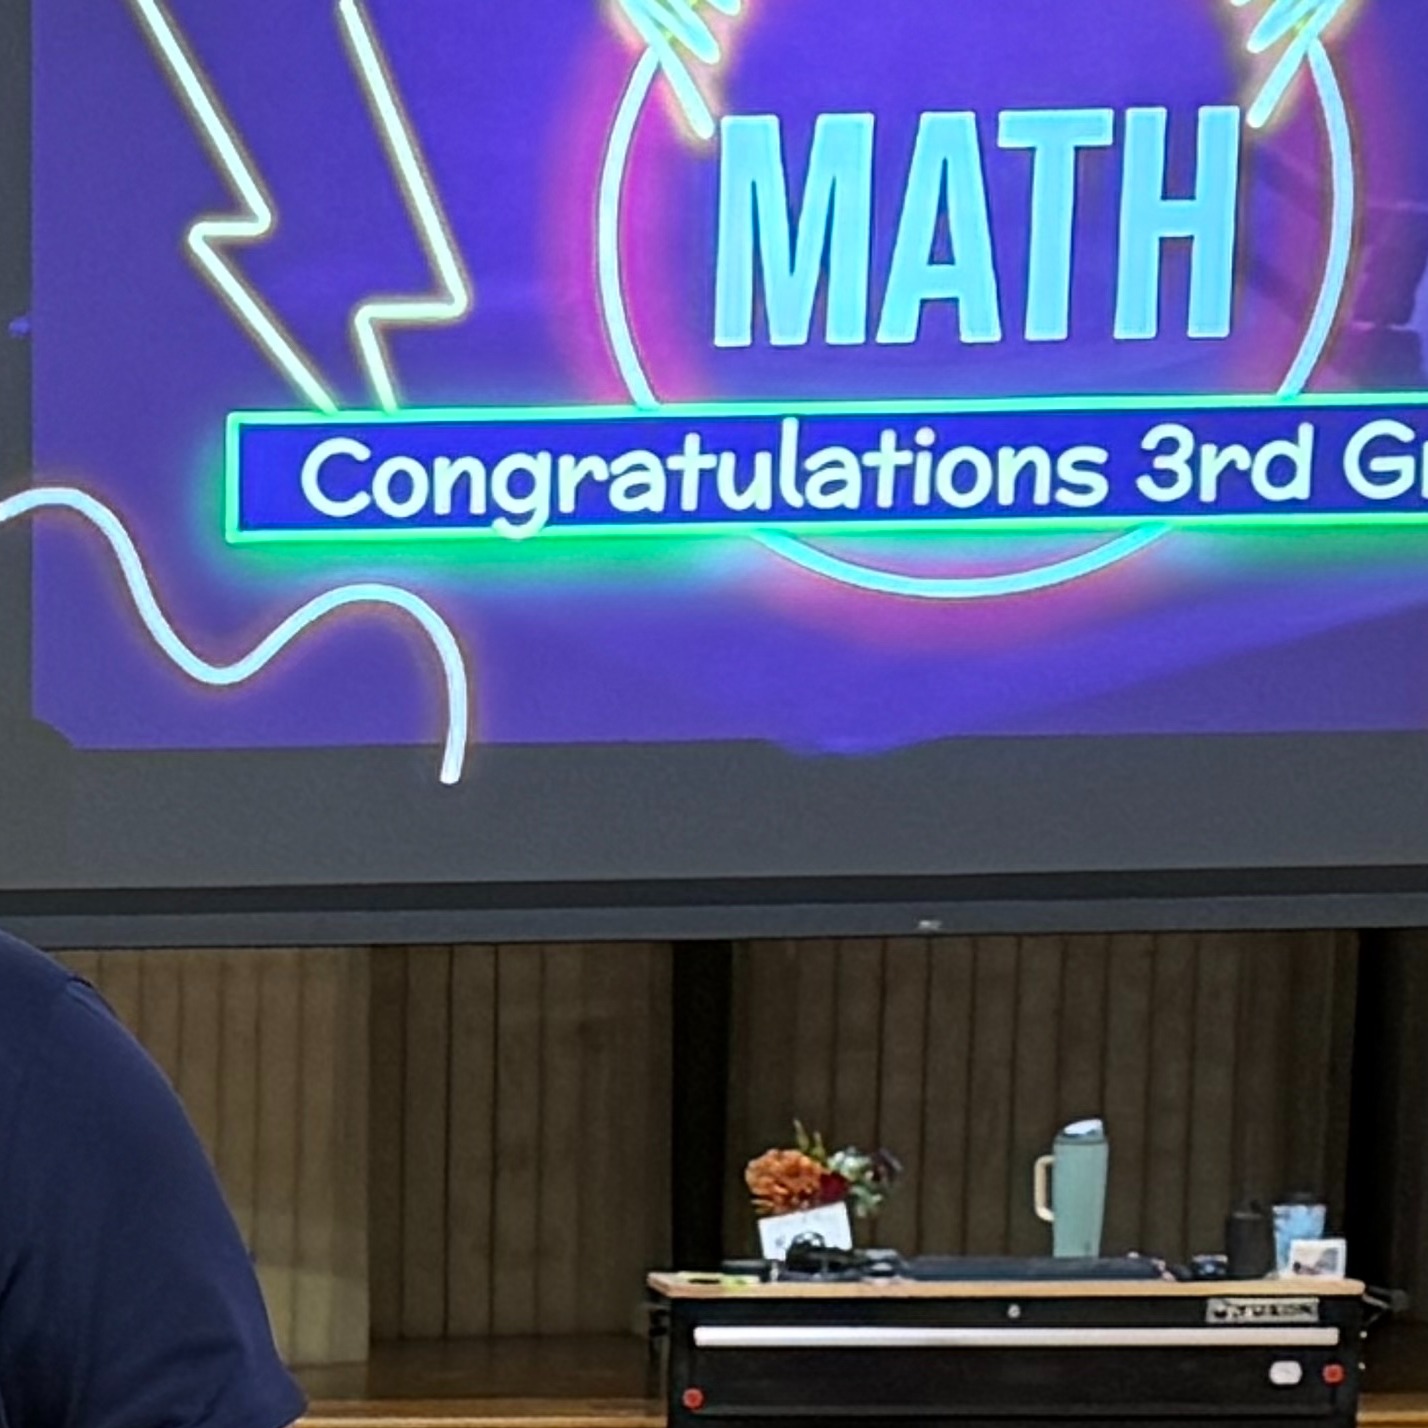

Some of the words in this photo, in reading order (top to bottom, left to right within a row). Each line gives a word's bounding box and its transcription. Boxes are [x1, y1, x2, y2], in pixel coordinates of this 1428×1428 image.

[713, 104, 1241, 348] MATH
[300, 415, 1110, 540] Congratulations
[1135, 421, 1315, 503] 3rd
[1343, 418, 1428, 500] G
